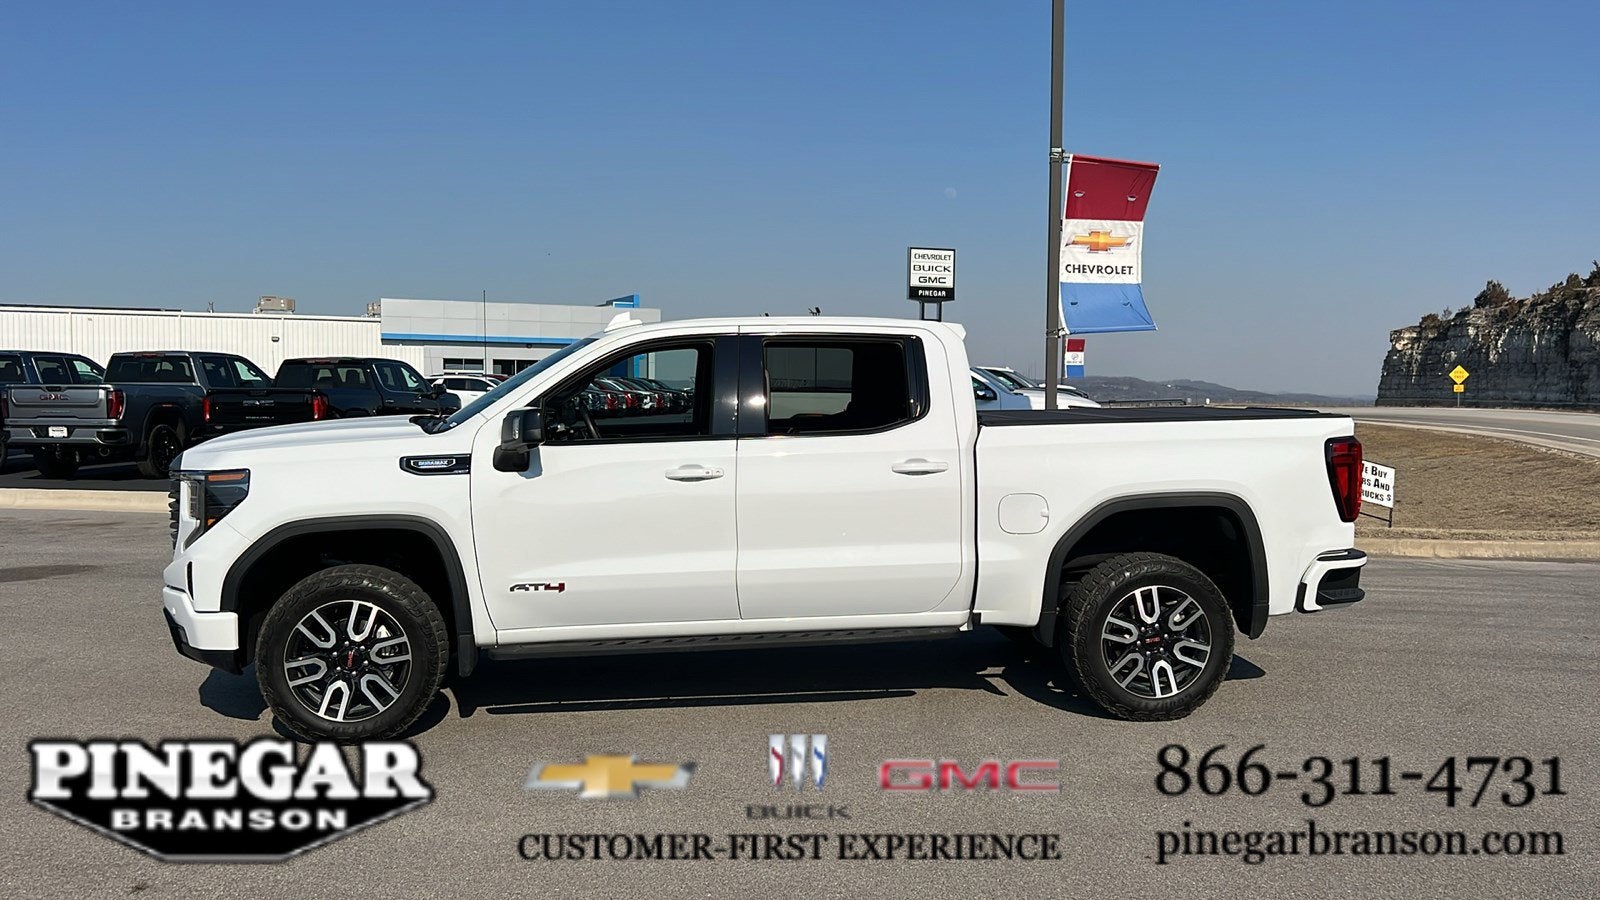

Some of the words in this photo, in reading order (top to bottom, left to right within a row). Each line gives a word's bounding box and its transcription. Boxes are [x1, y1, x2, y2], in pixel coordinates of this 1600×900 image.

[914, 253, 952, 261] CHEVROLET
[913, 264, 952, 273] BUICK
[1065, 263, 1134, 275] CHEVROLET
[918, 276, 947, 284] GMC
[918, 289, 947, 297] PINEGAR
[1371, 465, 1388, 478] BUY
[1374, 478, 1390, 492] AND
[1361, 489, 1384, 502] RUCKS
[509, 582, 566, 593] AT4
